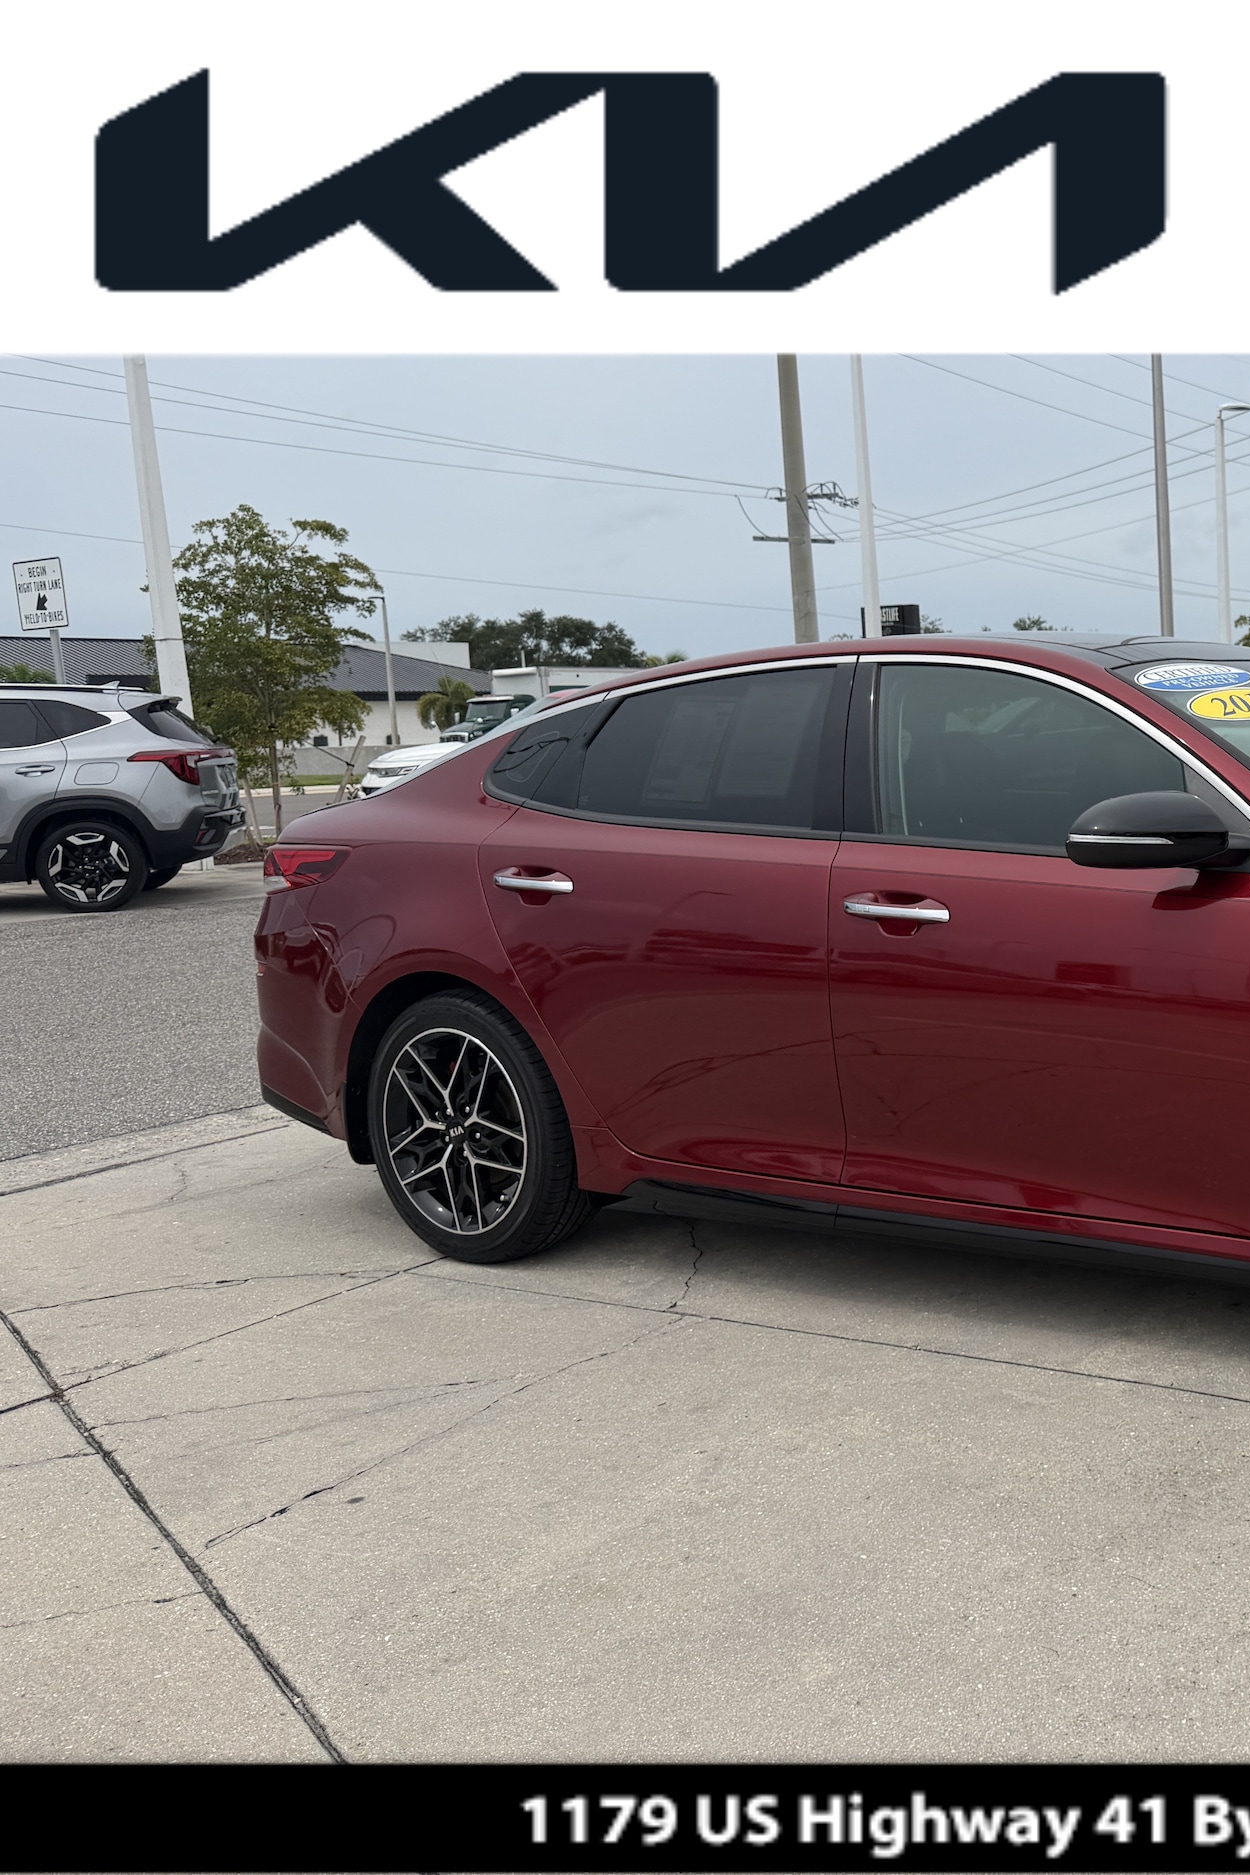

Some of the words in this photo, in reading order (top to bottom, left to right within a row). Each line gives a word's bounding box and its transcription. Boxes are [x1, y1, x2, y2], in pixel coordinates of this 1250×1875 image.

[28, 566, 46, 577] BEGIN
[18, 582, 32, 593] RIGHT
[33, 580, 47, 592] TURN
[48, 578, 62, 590] LANE
[24, 613, 39, 624] YIELD
[39, 612, 48, 623] TO
[48, 610, 64, 622] BIKES
[1143, 666, 1231, 680] CERTIFIED
[1162, 673, 1239, 687] PRE-OWNED
[1181, 679, 1239, 688] VEHICLE
[448, 1125, 465, 1138] KIA
